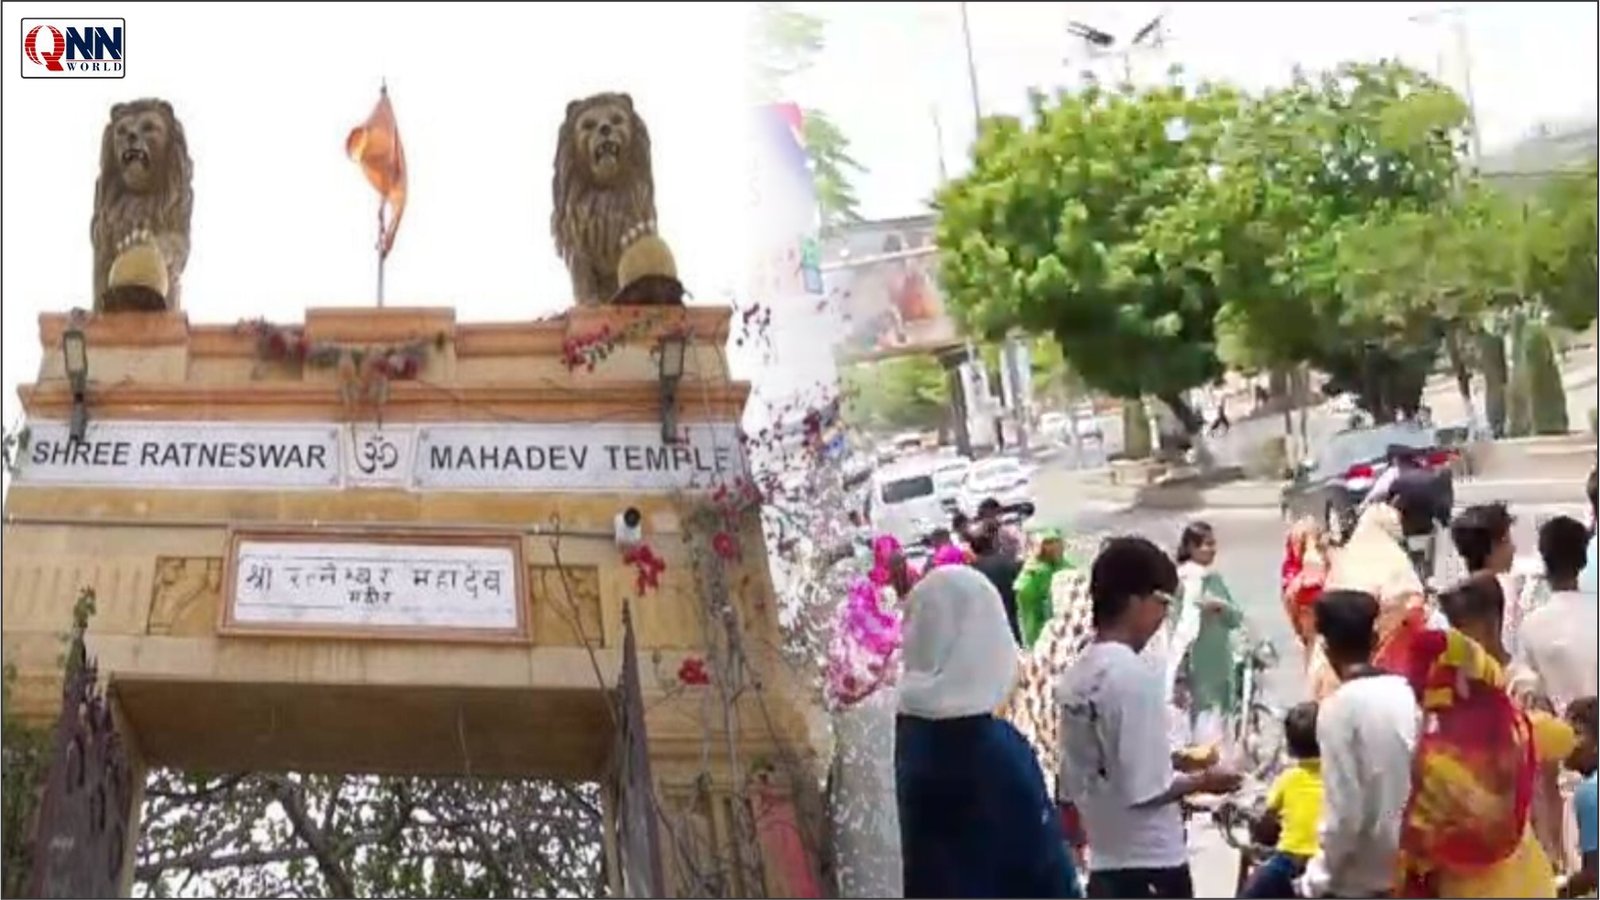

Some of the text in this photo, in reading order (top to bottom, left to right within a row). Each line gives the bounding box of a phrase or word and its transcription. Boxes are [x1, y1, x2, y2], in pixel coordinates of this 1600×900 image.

[32, 441, 326, 469] SHREE RATNESWAR
[430, 445, 730, 472] MAHADEV TEMPLE
